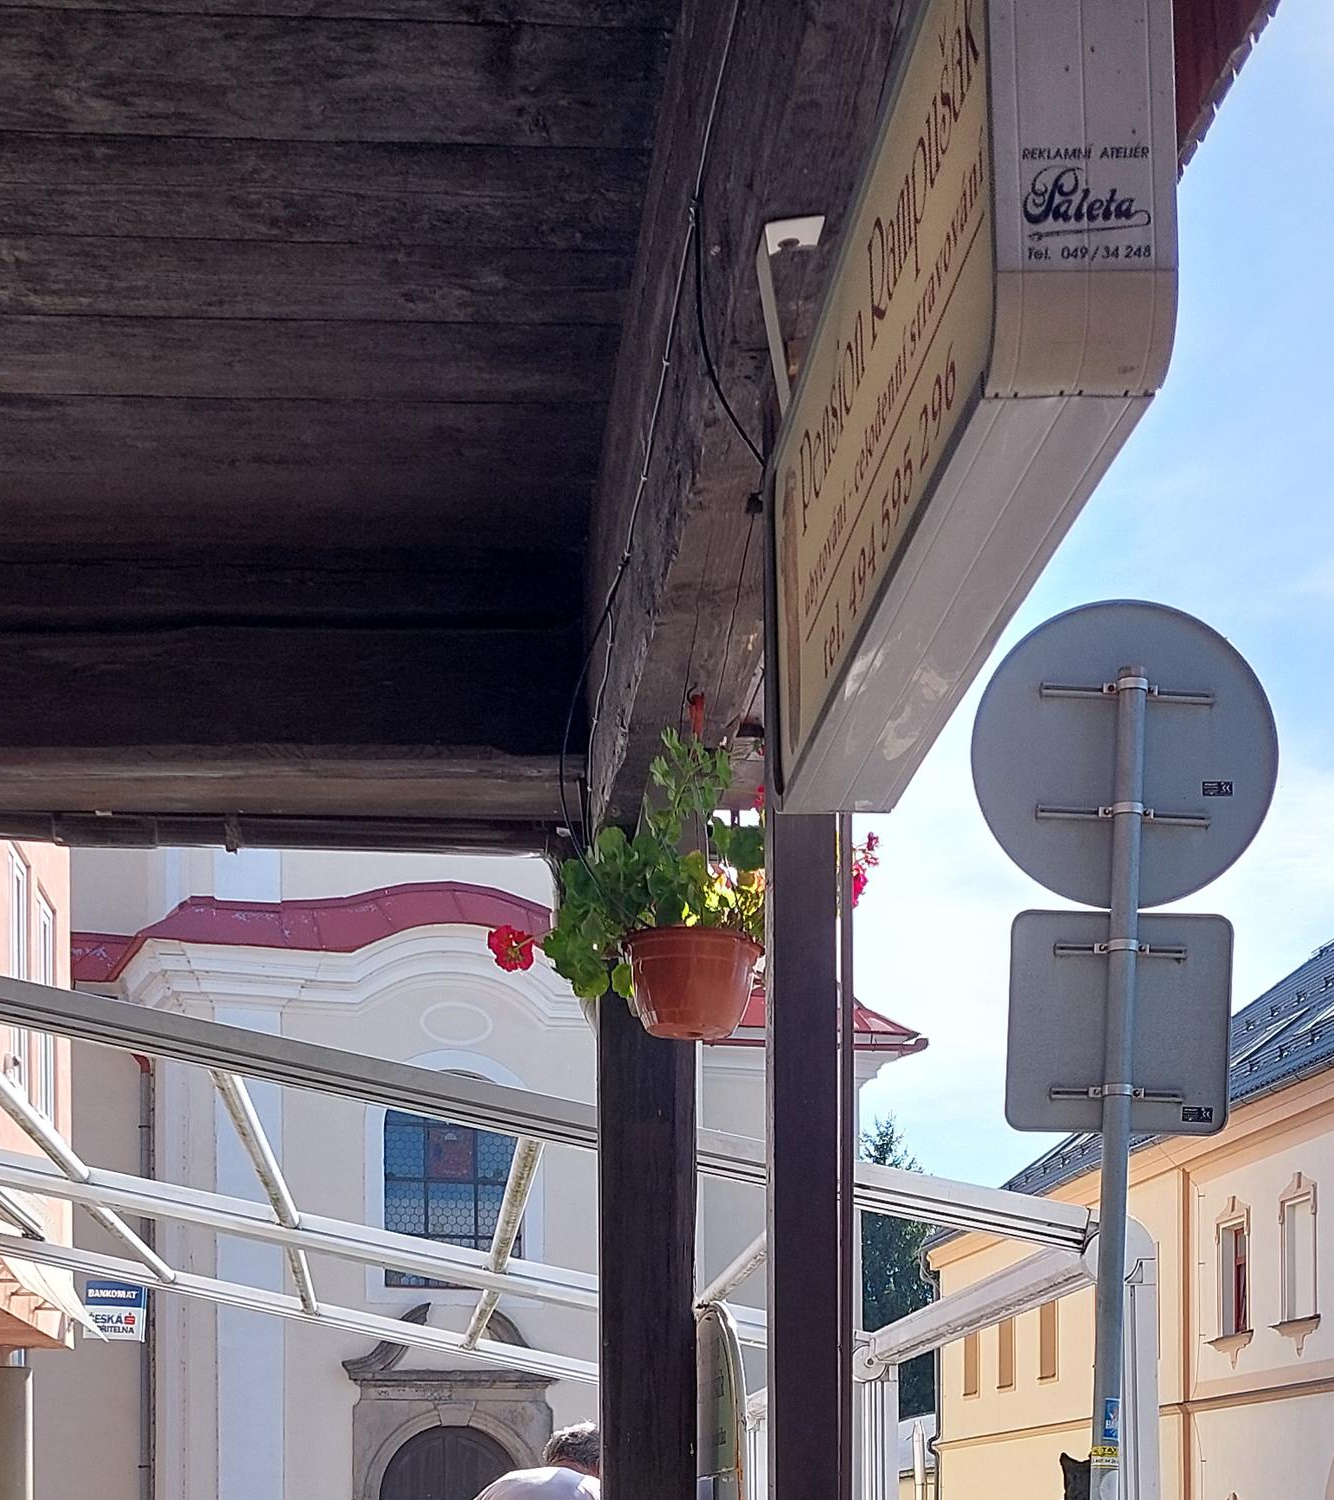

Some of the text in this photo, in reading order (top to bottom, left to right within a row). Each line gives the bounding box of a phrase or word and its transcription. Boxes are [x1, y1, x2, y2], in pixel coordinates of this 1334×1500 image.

[1022, 142, 1150, 160] REKLAMNÍ ATELIÉR
[1023, 165, 1152, 226] Paleta
[800, 0, 980, 537] Pension Rampušák
[1027, 246, 1051, 261] Tel.
[1124, 244, 1151, 259] 248
[804, 480, 847, 617] ubytování
[854, 324, 908, 493] celodenní
[909, 125, 984, 357] stravování
[849, 523, 877, 619] 494
[881, 435, 914, 552] 595
[919, 340, 957, 472] 296
[88, 1288, 139, 1299] BANKOMAT
